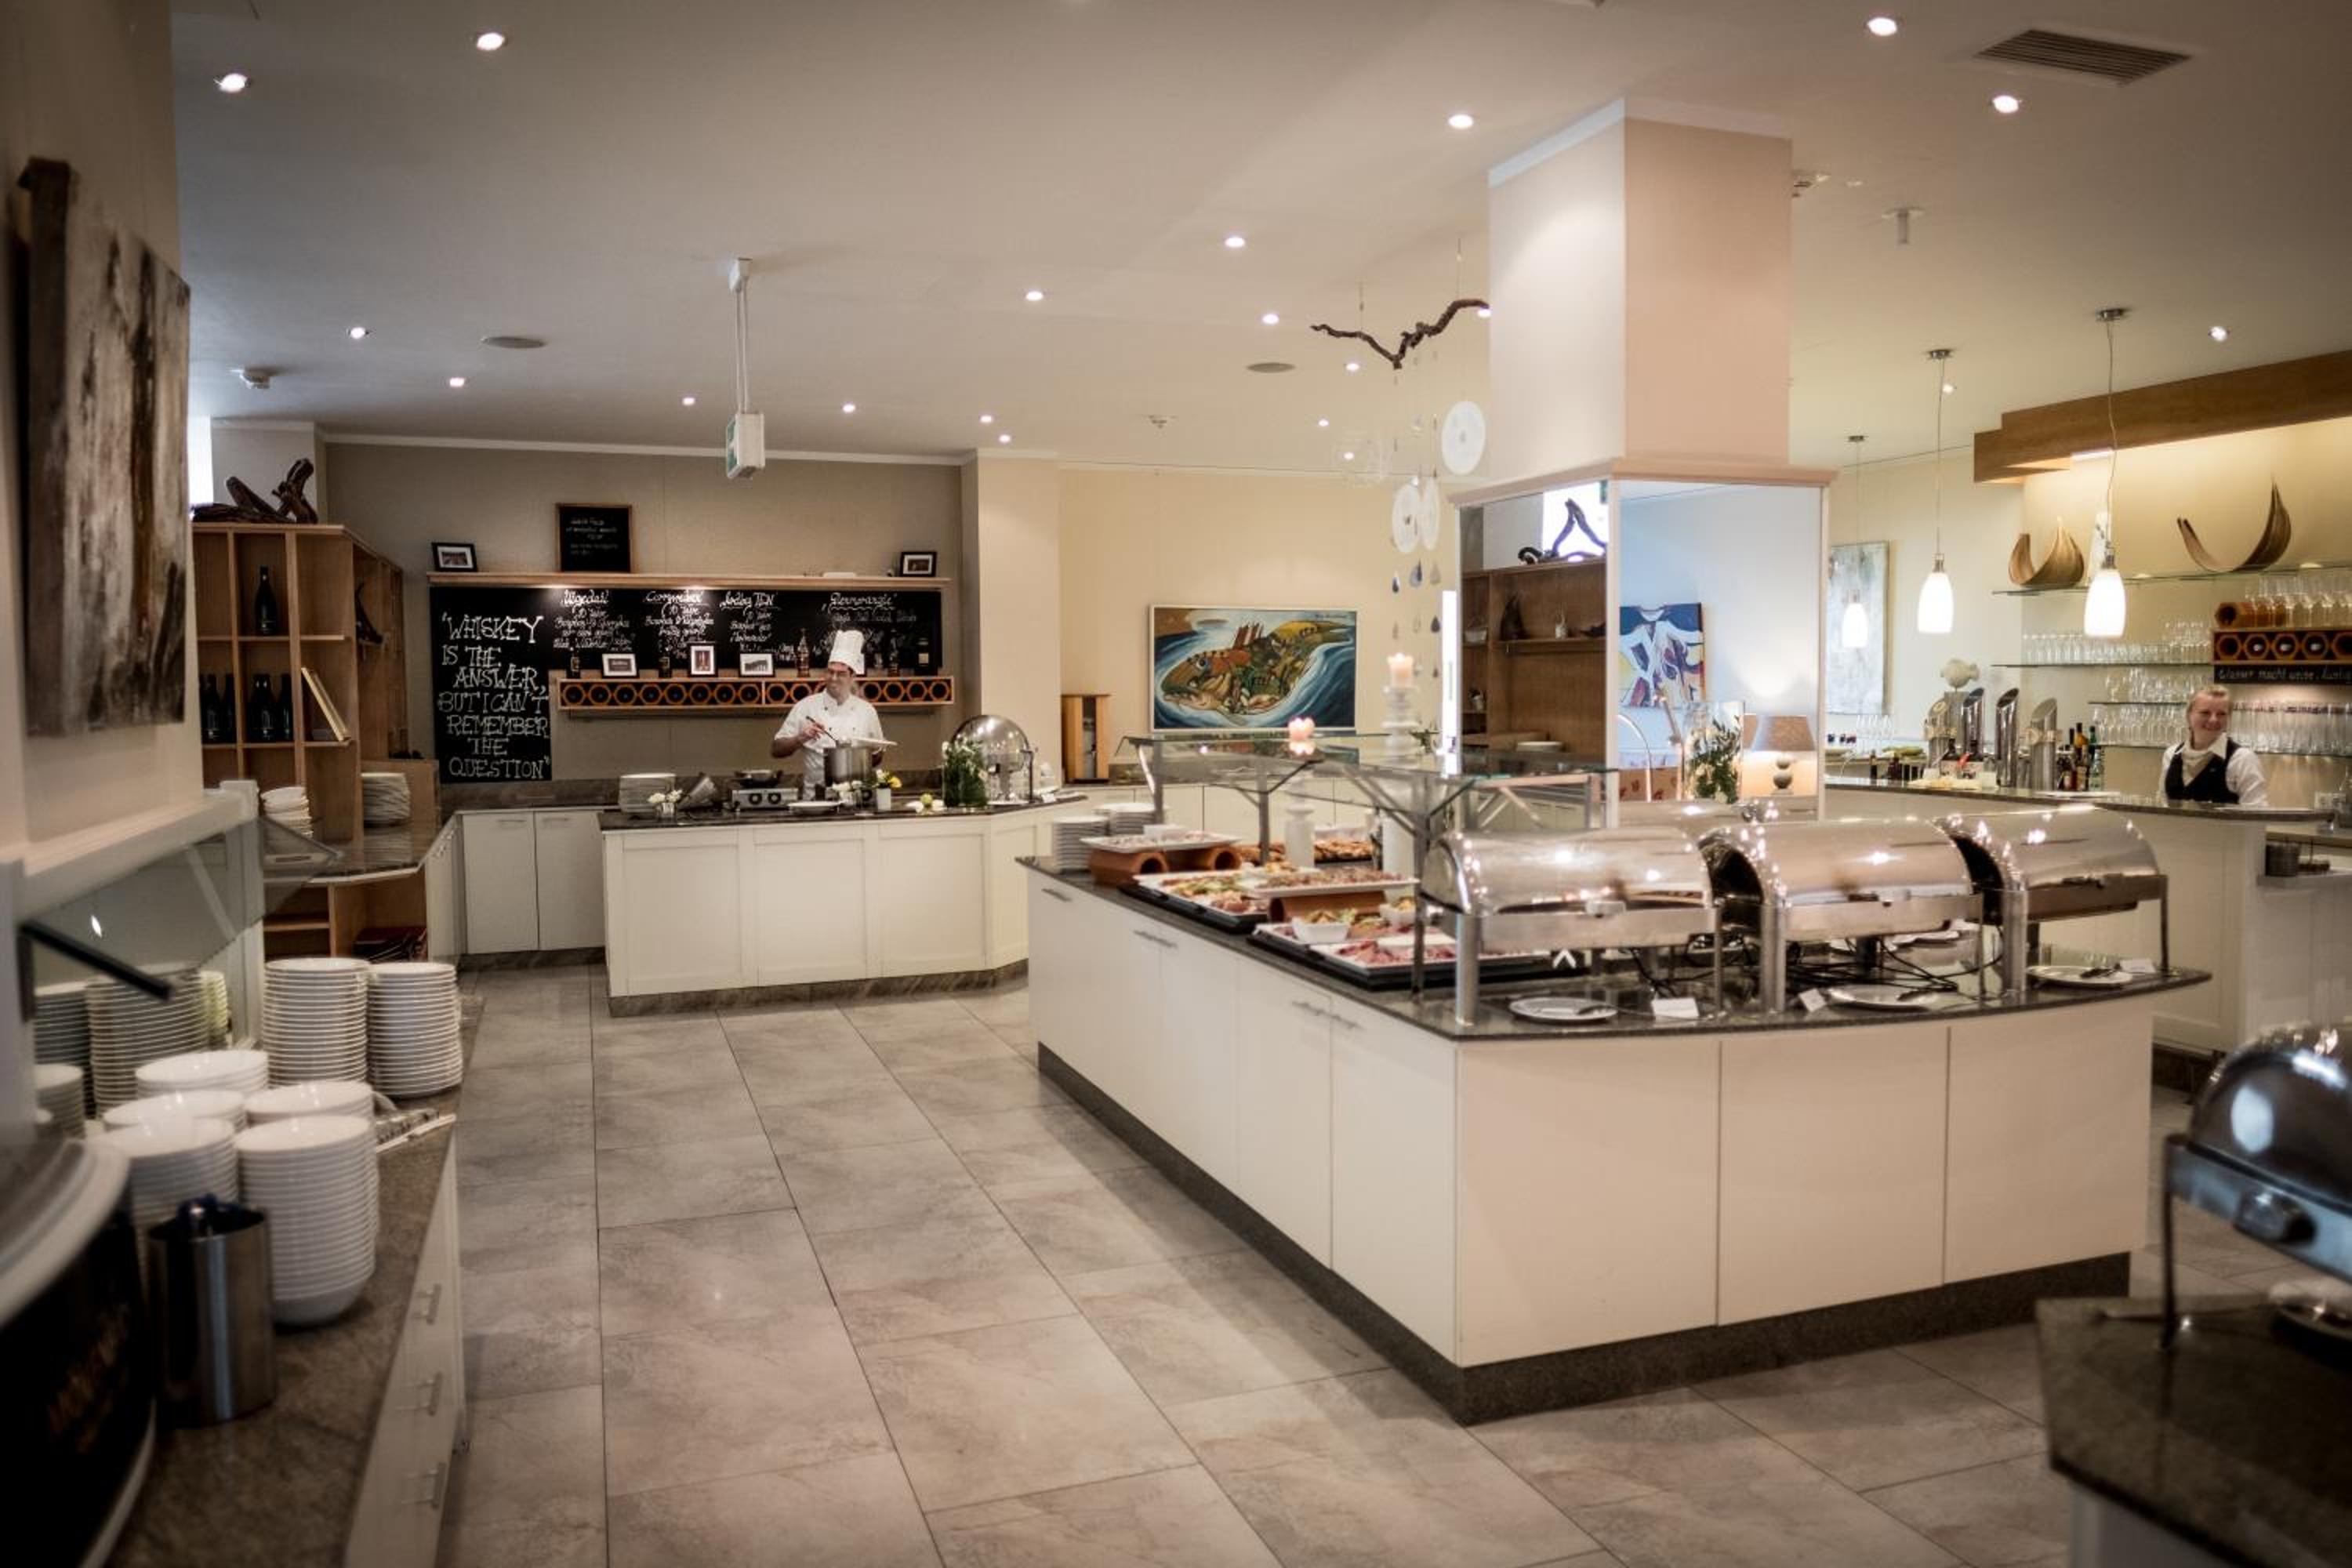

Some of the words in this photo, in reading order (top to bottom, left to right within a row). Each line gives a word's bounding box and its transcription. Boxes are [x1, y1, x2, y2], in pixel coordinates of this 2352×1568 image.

[441, 644, 459, 666] IS
[464, 645, 502, 668] THE
[452, 663, 546, 695] ANSWER,
[438, 691, 481, 713] BUT
[483, 692, 490, 713] I
[491, 691, 549, 714] CAN'T
[447, 714, 550, 739] REMEMBER
[466, 737, 510, 756] THE
